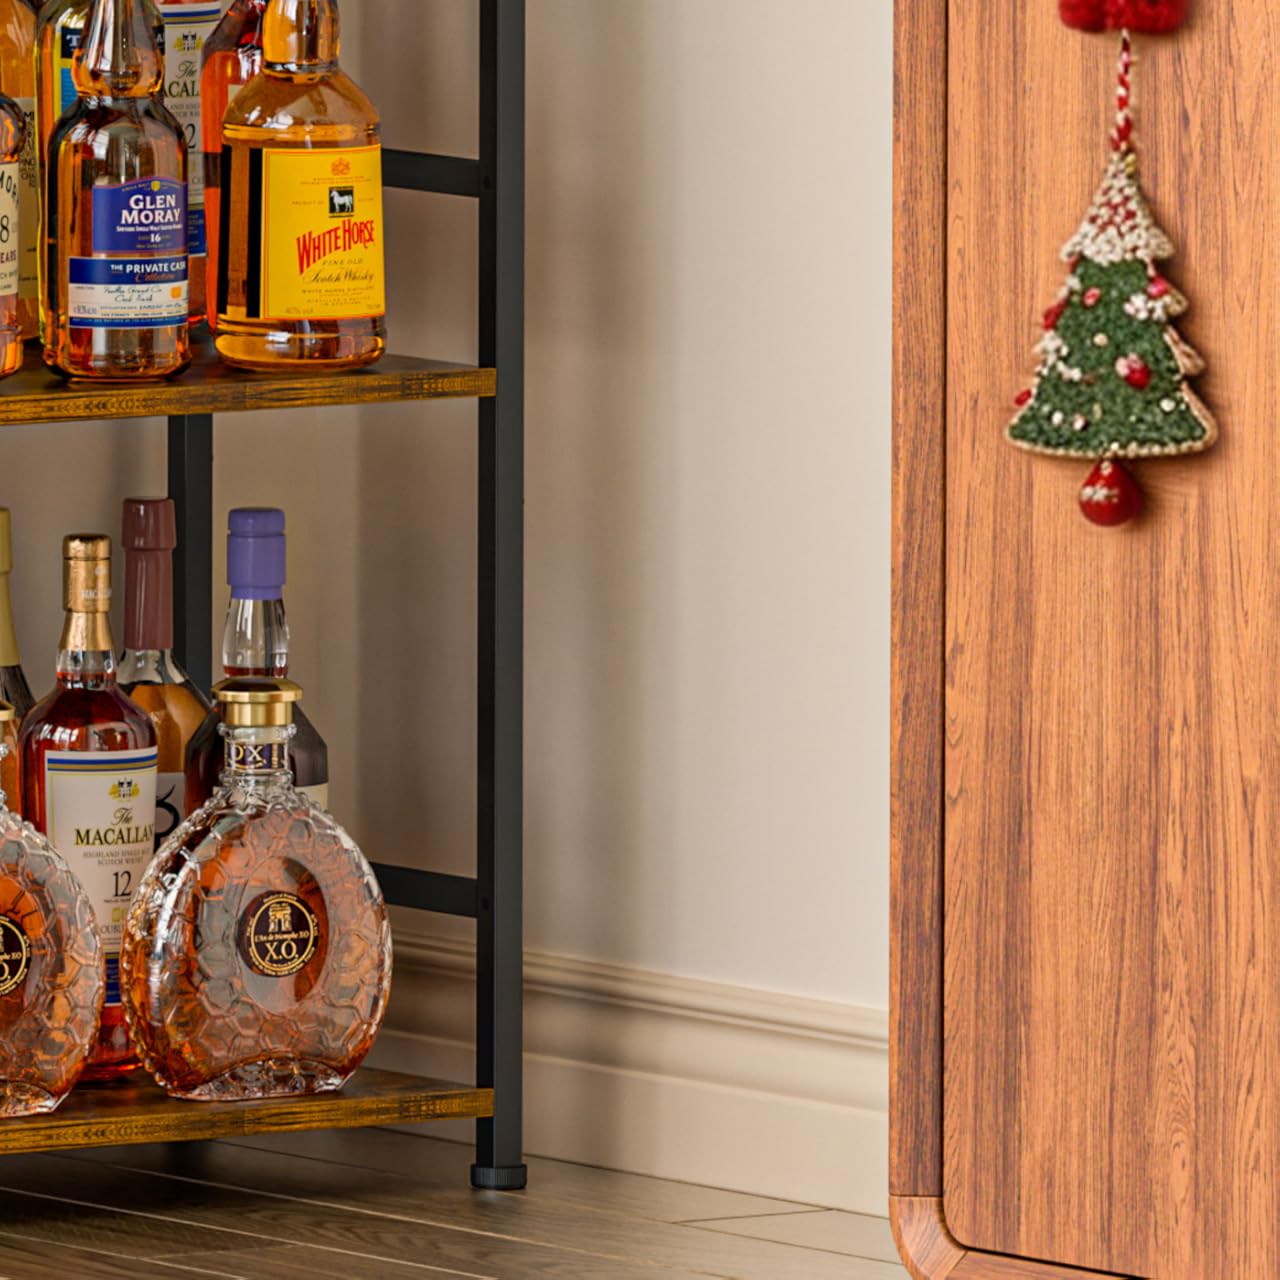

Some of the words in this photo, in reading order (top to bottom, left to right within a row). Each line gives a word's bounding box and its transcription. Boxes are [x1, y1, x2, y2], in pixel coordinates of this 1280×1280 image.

[173, 59, 198, 79] The
[128, 194, 176, 211] GLEN
[120, 208, 180, 225] MORAY
[149, 232, 160, 243] 16
[296, 226, 341, 276] WHITE
[341, 218, 375, 251] HORSE
[110, 263, 123, 271] THE
[126, 261, 169, 274] PRIVATE
[110, 806, 133, 827] The
[111, 870, 133, 899] 12
